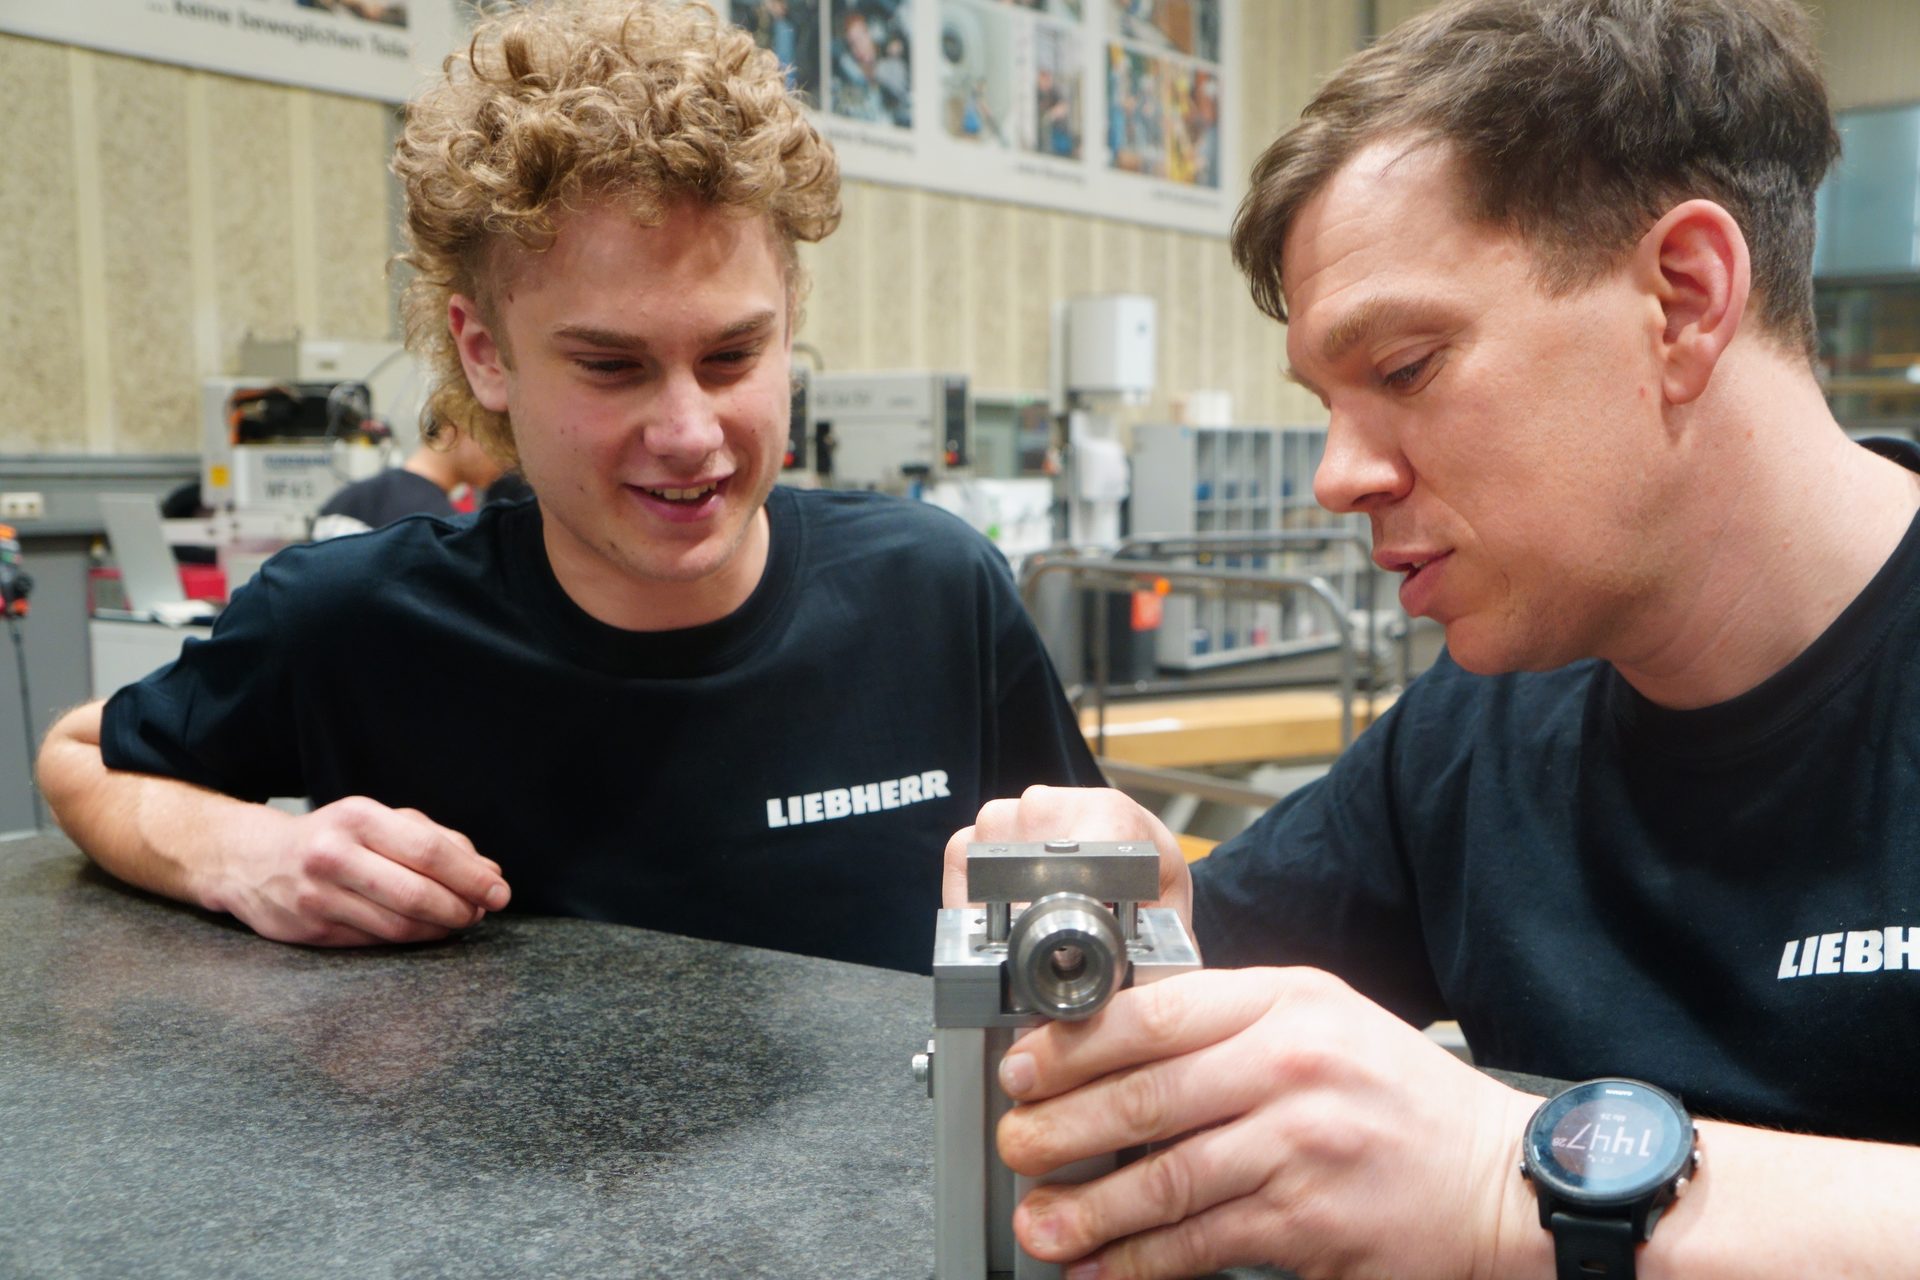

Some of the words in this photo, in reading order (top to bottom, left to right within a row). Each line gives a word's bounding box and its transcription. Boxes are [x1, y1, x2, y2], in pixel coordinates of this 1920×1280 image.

[766, 769, 951, 828] LIEBHERR
[1551, 1136, 1568, 1148] 28
[1566, 1122, 1652, 1157] 1447
